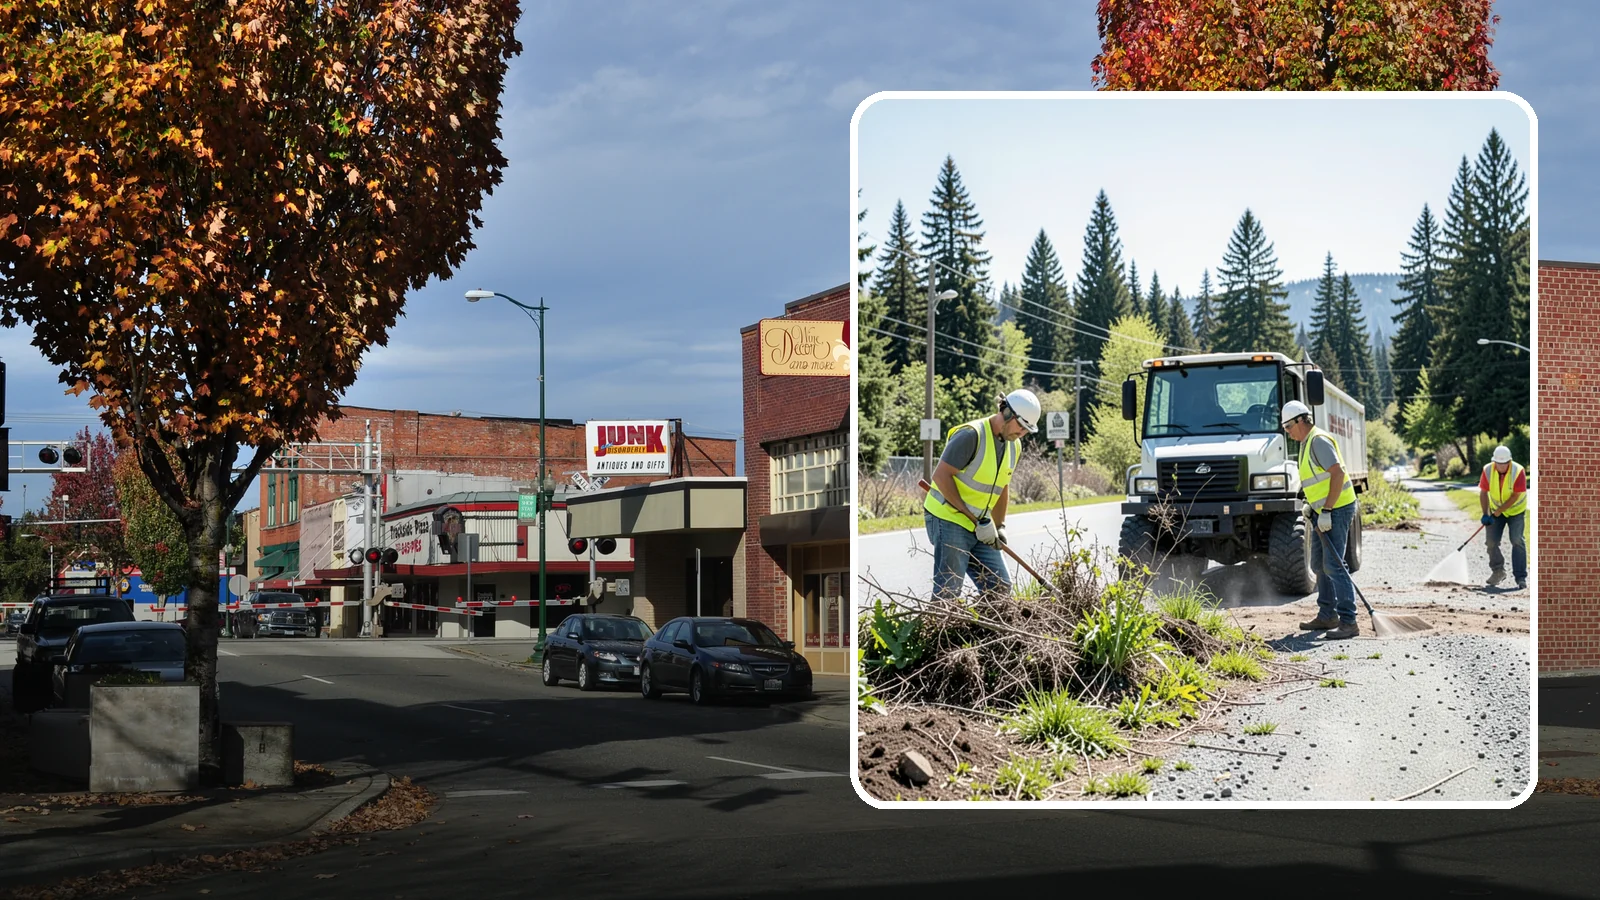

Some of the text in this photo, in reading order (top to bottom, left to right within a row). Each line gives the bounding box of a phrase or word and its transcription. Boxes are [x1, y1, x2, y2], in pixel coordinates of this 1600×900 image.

[596, 425, 664, 457] JUNK
[607, 446, 645, 454] DISORDERLY
[597, 461, 665, 470] ANTIQUES AND GIFTS
[352, 498, 365, 510] CRO
[414, 519, 429, 534] Pizza
